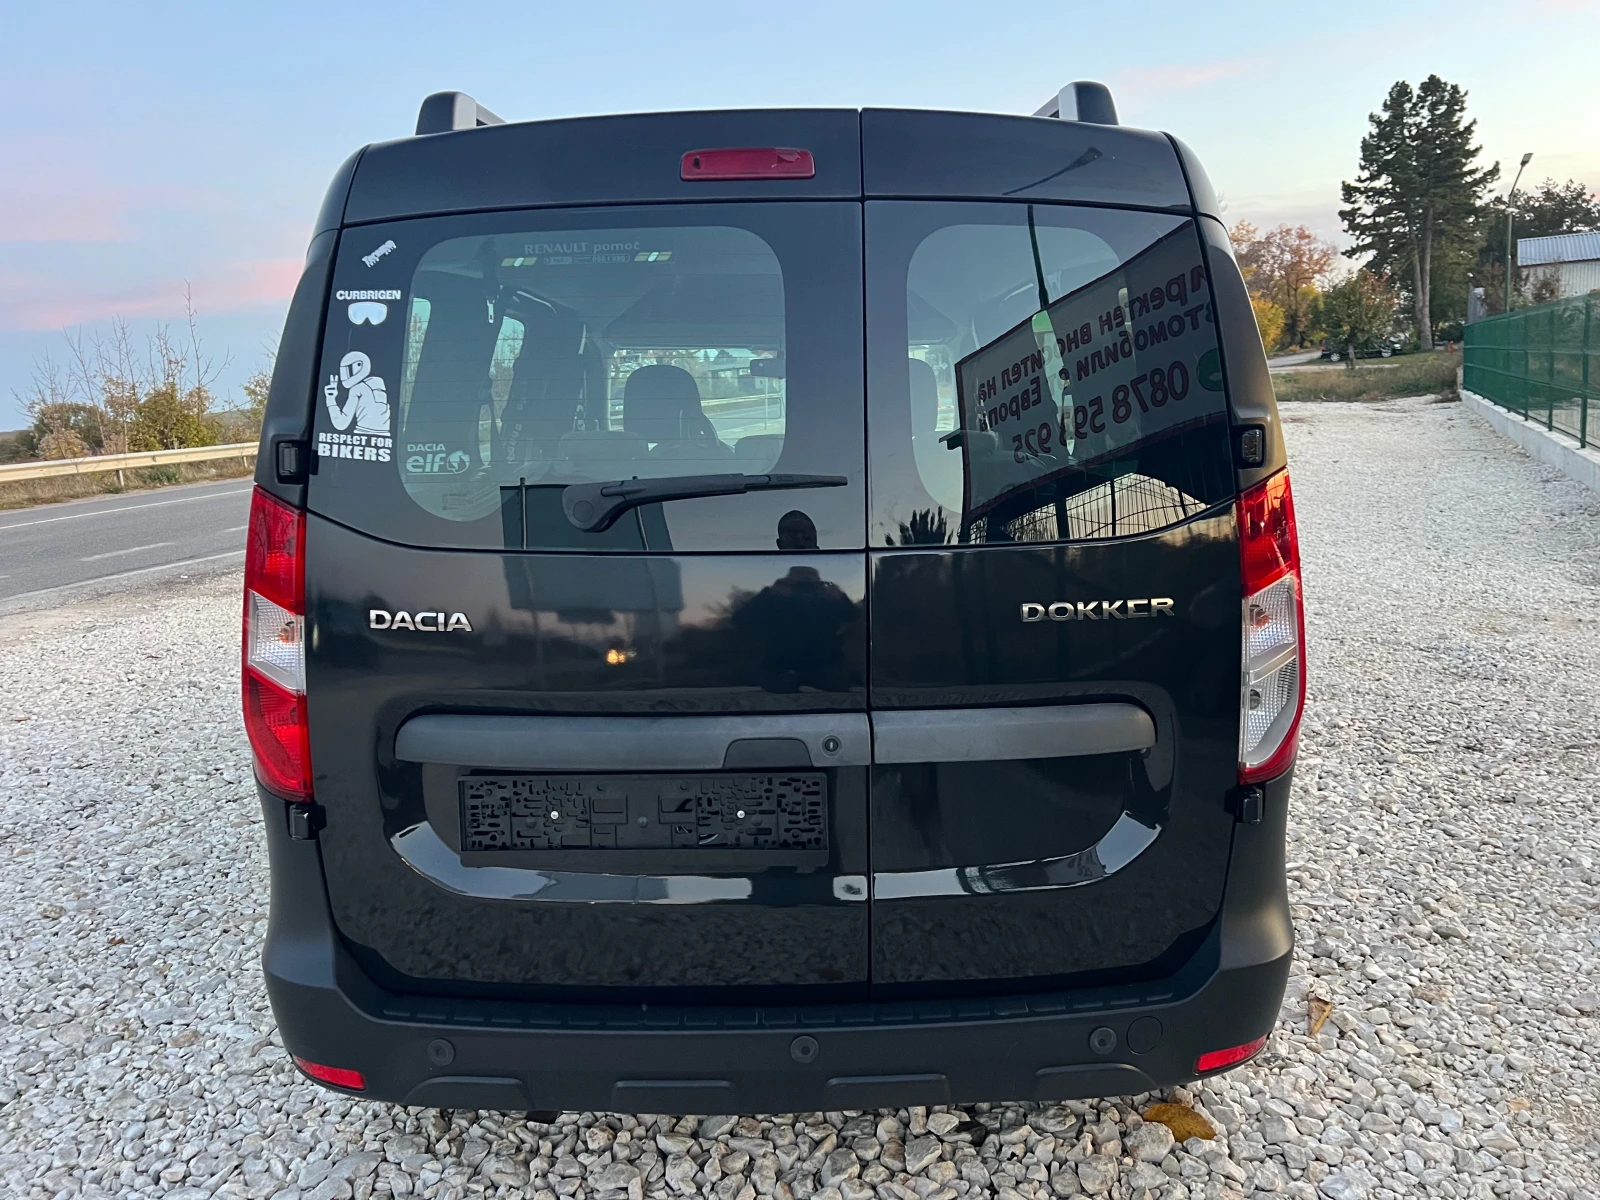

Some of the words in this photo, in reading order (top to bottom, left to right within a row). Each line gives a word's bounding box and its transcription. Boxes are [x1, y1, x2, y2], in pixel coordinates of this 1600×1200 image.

[524, 242, 588, 254] RENAULT
[336, 289, 401, 300] CURBRIGEN
[318, 432, 367, 446] RESPECT
[370, 436, 393, 448] FOR
[407, 443, 446, 452] DACIA
[317, 443, 391, 462] BIKERS
[405, 453, 446, 472] elf
[1021, 597, 1175, 622] DOKKER
[369, 609, 473, 632] DACIA
